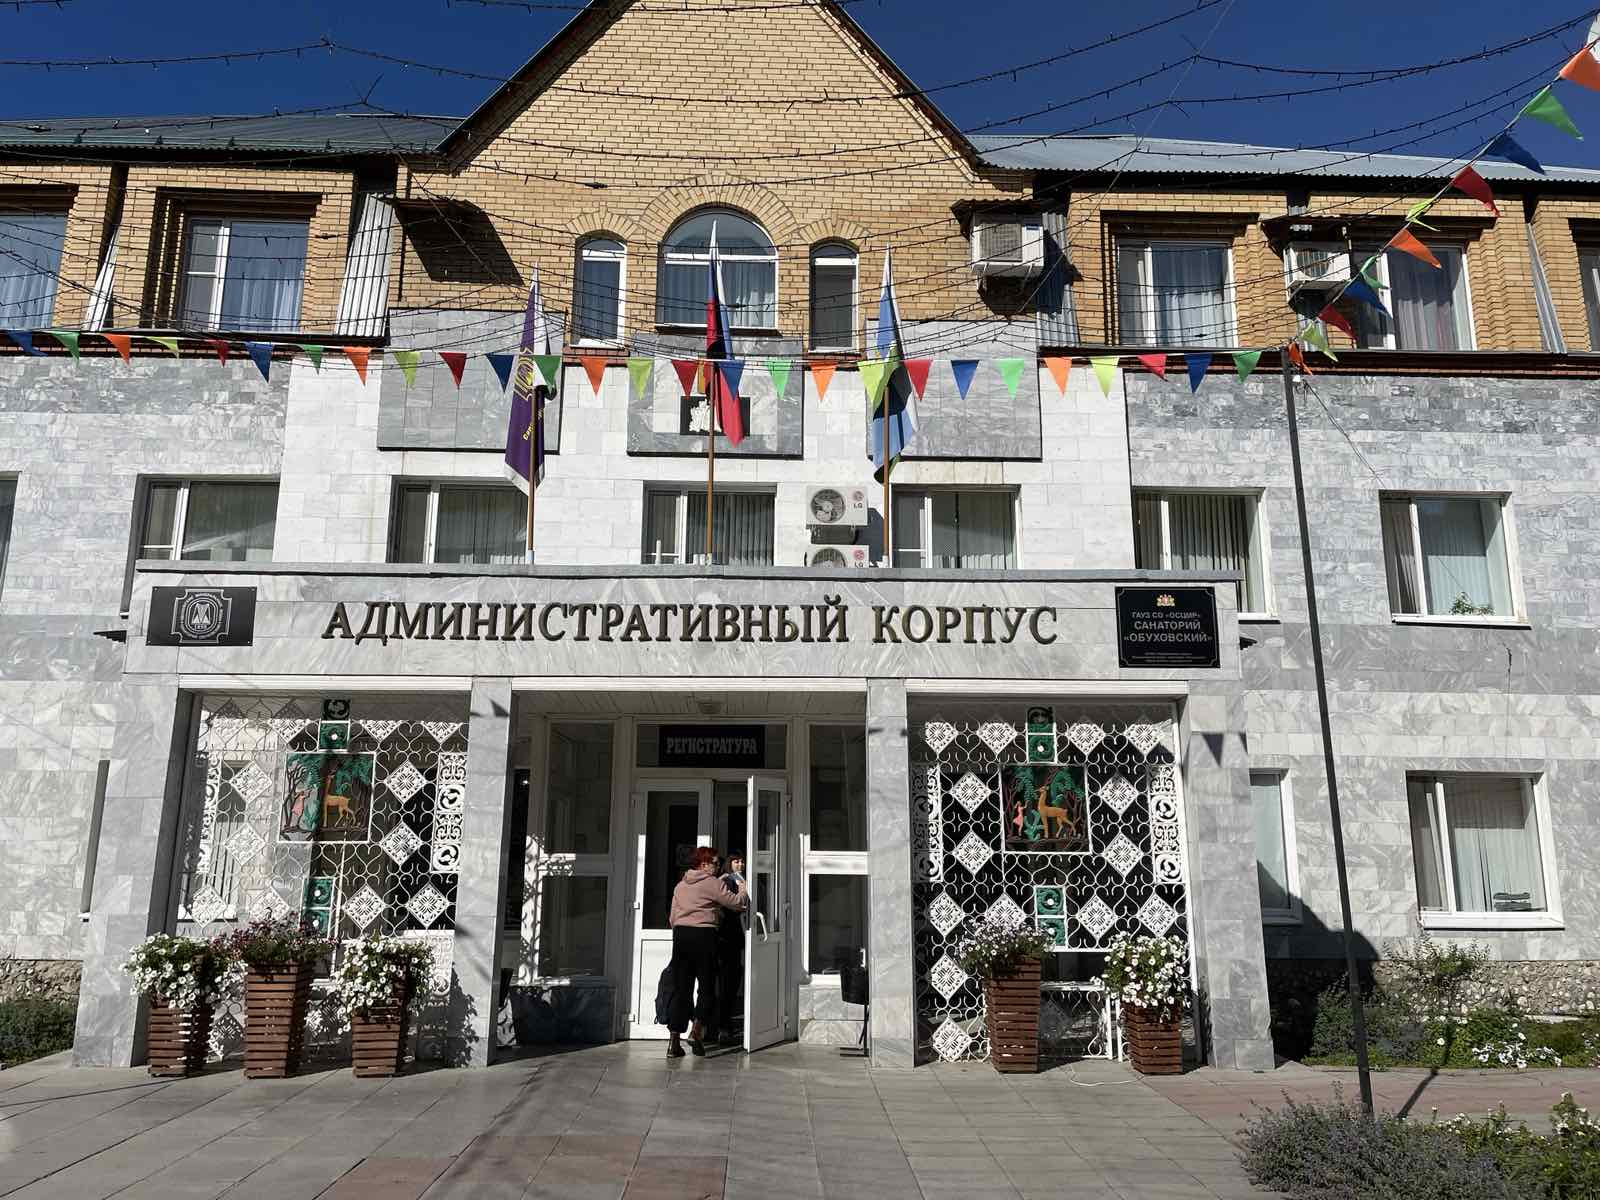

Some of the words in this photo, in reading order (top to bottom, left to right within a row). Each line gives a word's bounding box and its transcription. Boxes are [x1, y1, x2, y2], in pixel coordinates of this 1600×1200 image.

[320, 594, 849, 646] АДМИНИСТРАТИВНЫЙ
[871, 604, 1058, 645] КОРПУС
[1152, 611, 1164, 619] СО
[1133, 619, 1201, 630] САНАТОРИЙ
[1123, 632, 1213, 642] «ОБУХОВСКИЙ»
[666, 737, 758, 754] РЕГИСТРАТУРА
